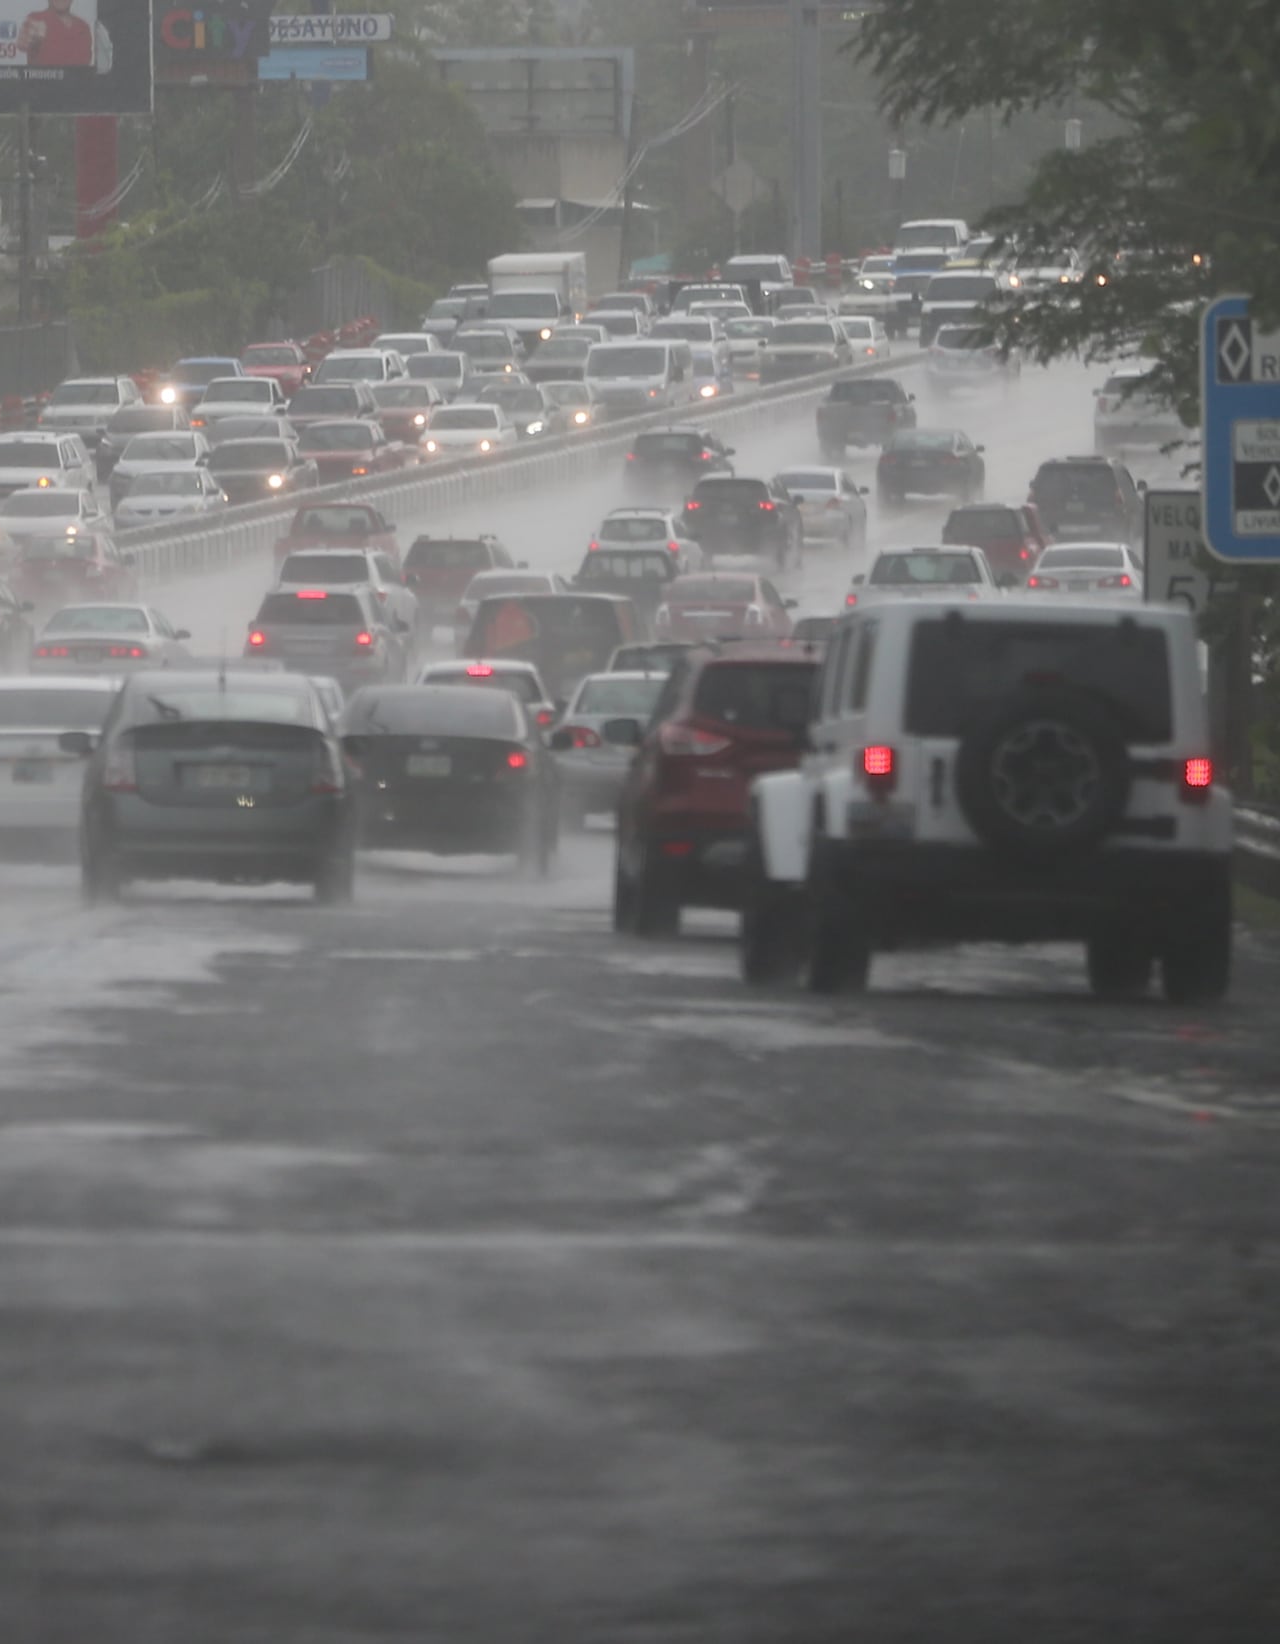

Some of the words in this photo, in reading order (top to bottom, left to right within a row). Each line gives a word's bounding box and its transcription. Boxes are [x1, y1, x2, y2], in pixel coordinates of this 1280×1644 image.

[161, 8, 256, 58] City
[1261, 355, 1280, 378] R
[1152, 505, 1199, 527] VELO
[1168, 539, 1195, 560] MA
